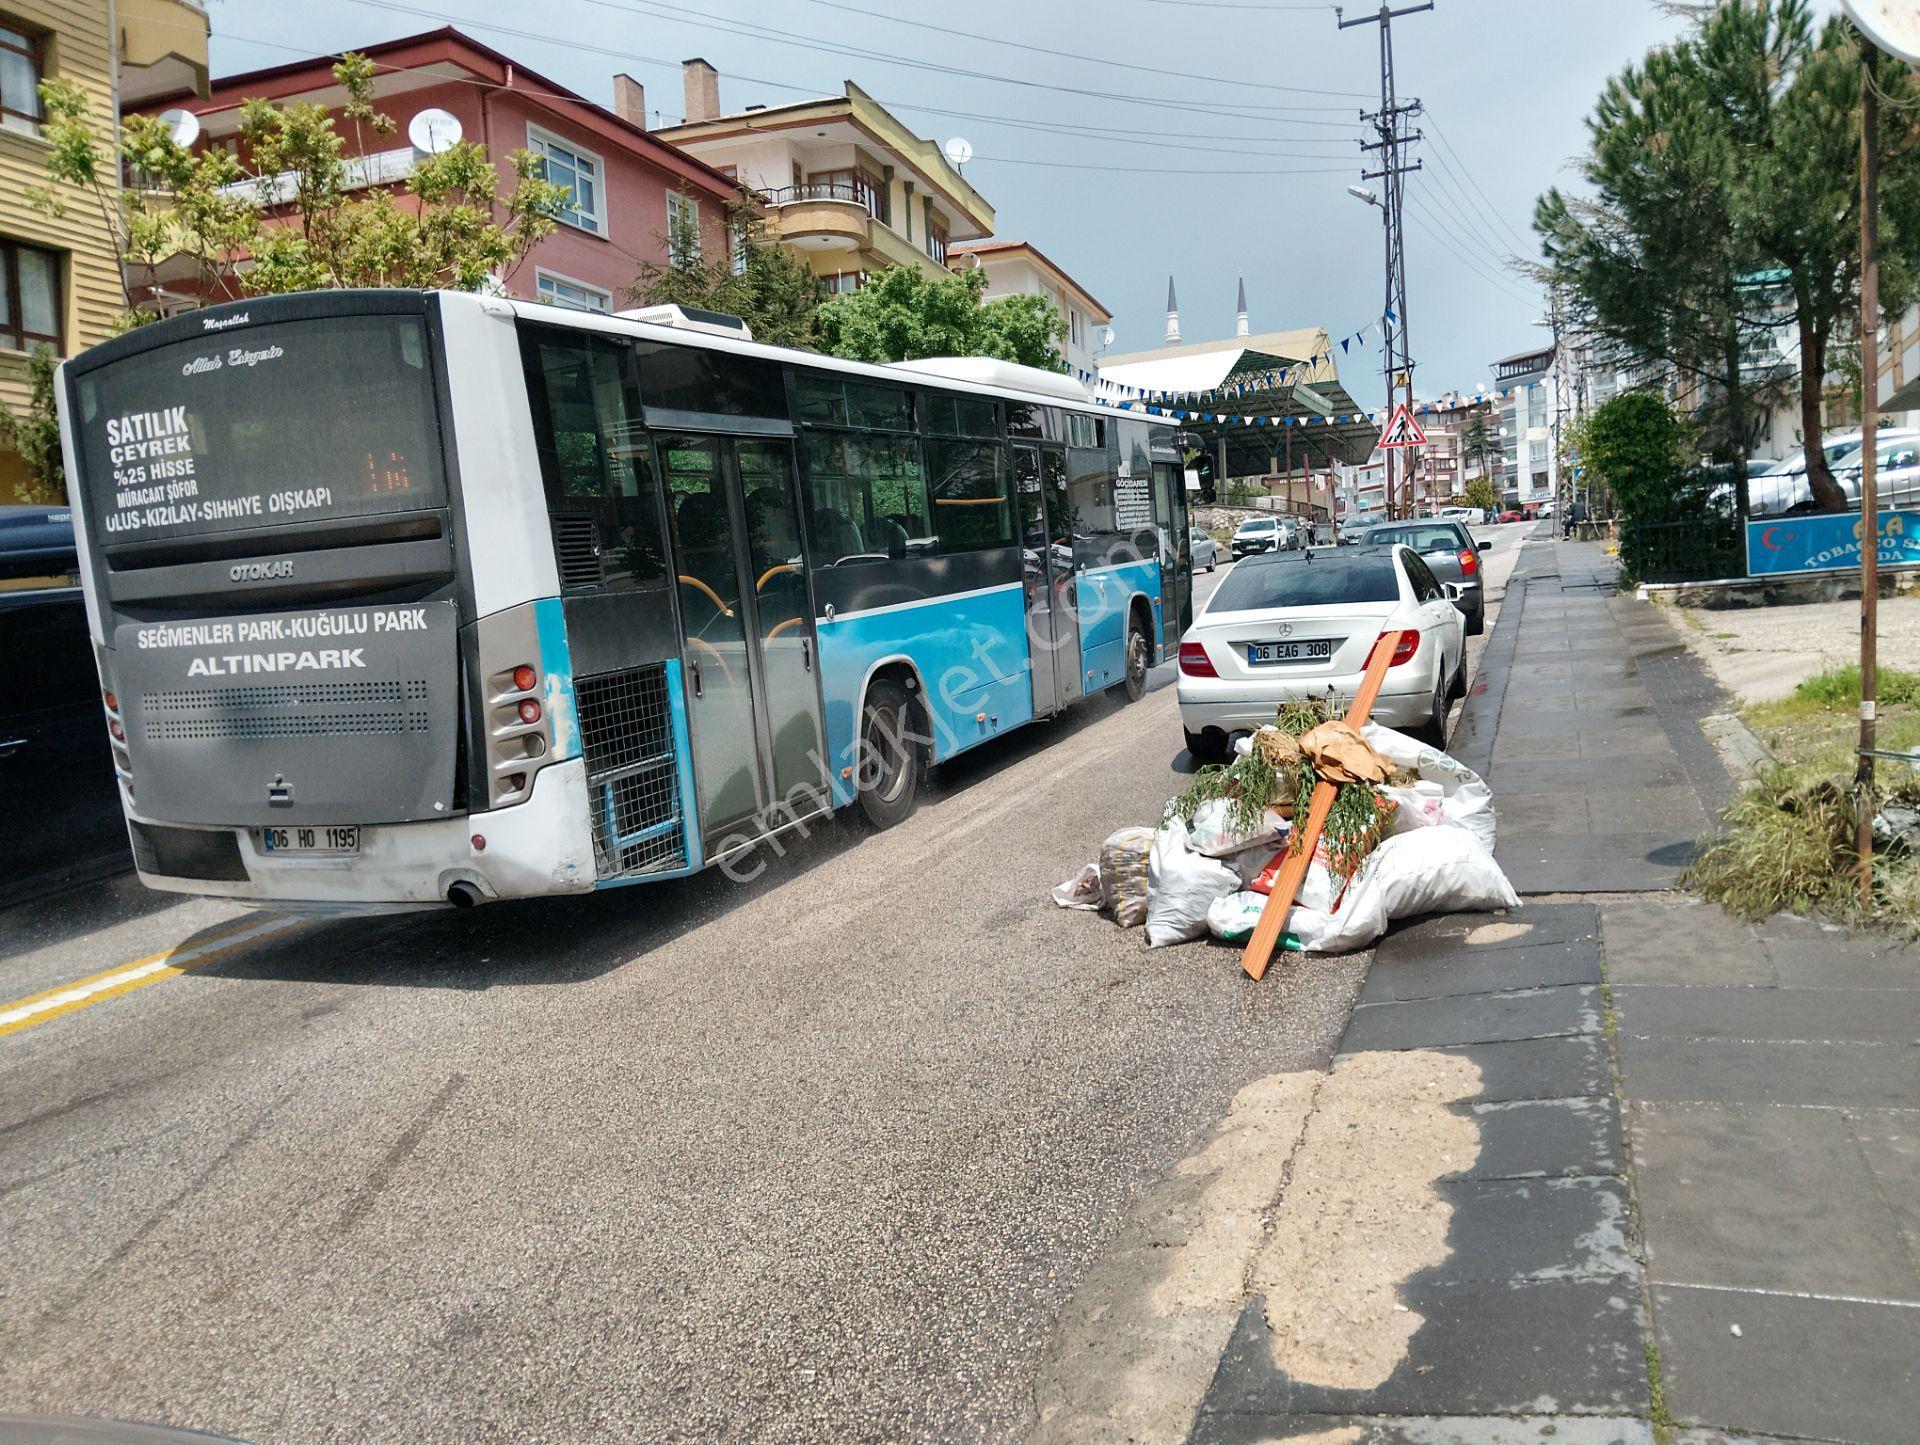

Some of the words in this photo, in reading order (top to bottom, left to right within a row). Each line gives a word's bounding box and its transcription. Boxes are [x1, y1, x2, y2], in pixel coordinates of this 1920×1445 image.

[182, 355, 222, 376] Allah
[228, 345, 283, 367] Esirgesin
[106, 405, 189, 446] SATILIK
[110, 435, 192, 468] ÇEYREK
[113, 466, 146, 487] %25
[150, 458, 195, 480] HİSSE
[116, 485, 165, 509] MÜRACAAT
[229, 560, 294, 582] OTOKAR
[138, 624, 234, 649] SEĞMENLER
[374, 609, 427, 632] PARK
[187, 648, 367, 677] ALTINPARK
[1256, 647, 1270, 659] 06
[1277, 645, 1299, 658] EAG
[1307, 643, 1329, 656] 308
[272, 829, 289, 848] 06
[326, 828, 355, 848] 1195
